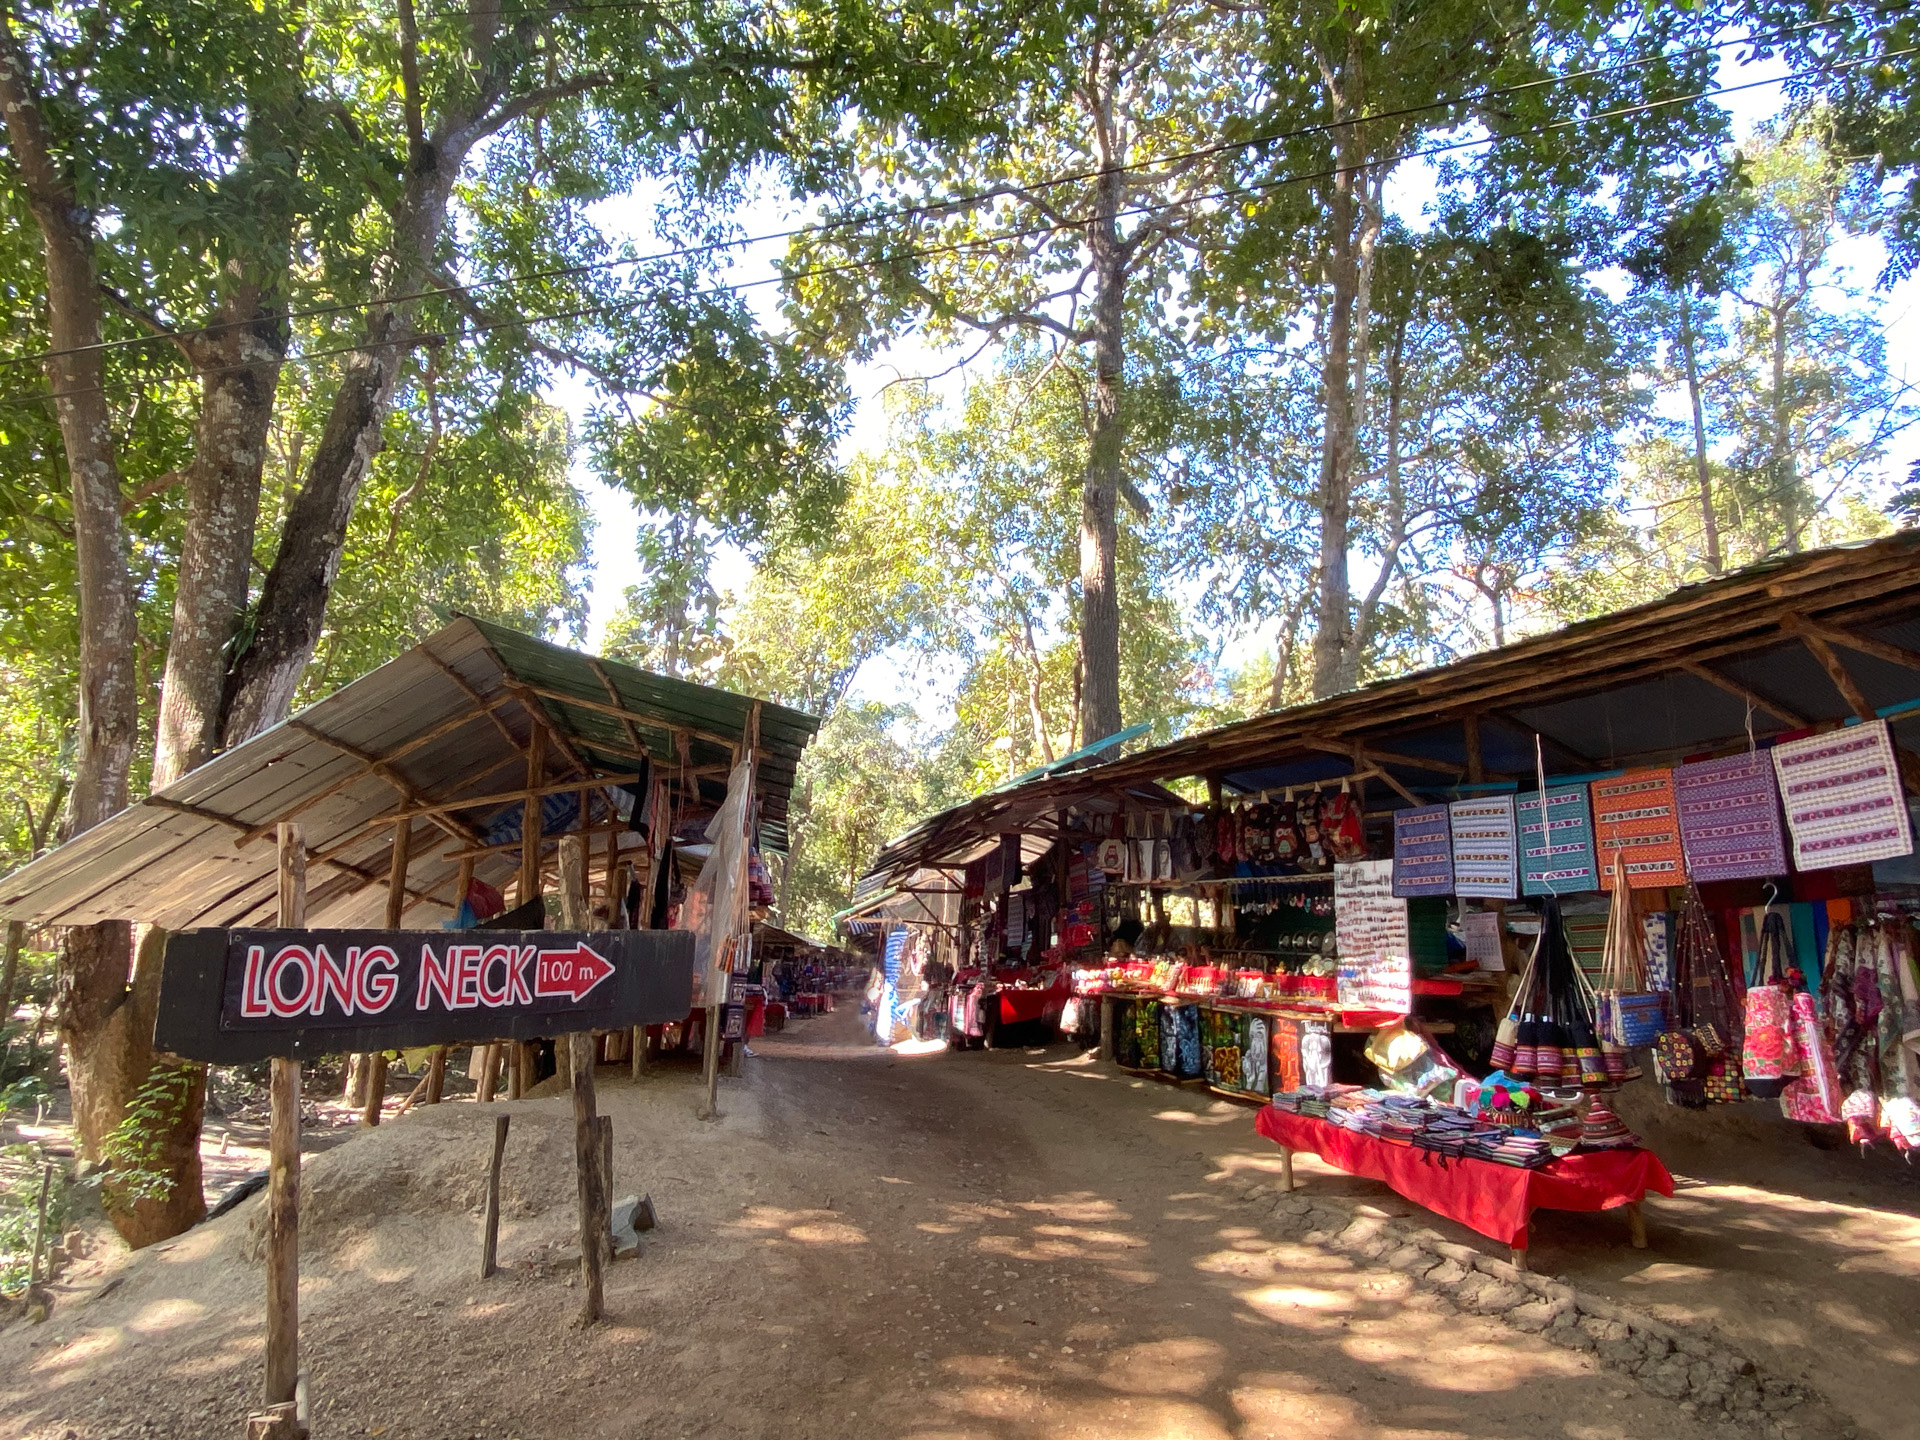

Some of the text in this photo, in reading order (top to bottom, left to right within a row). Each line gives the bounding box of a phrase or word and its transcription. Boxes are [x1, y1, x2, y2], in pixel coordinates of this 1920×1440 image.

[241, 944, 598, 1018] LONG NECK 100 m.
